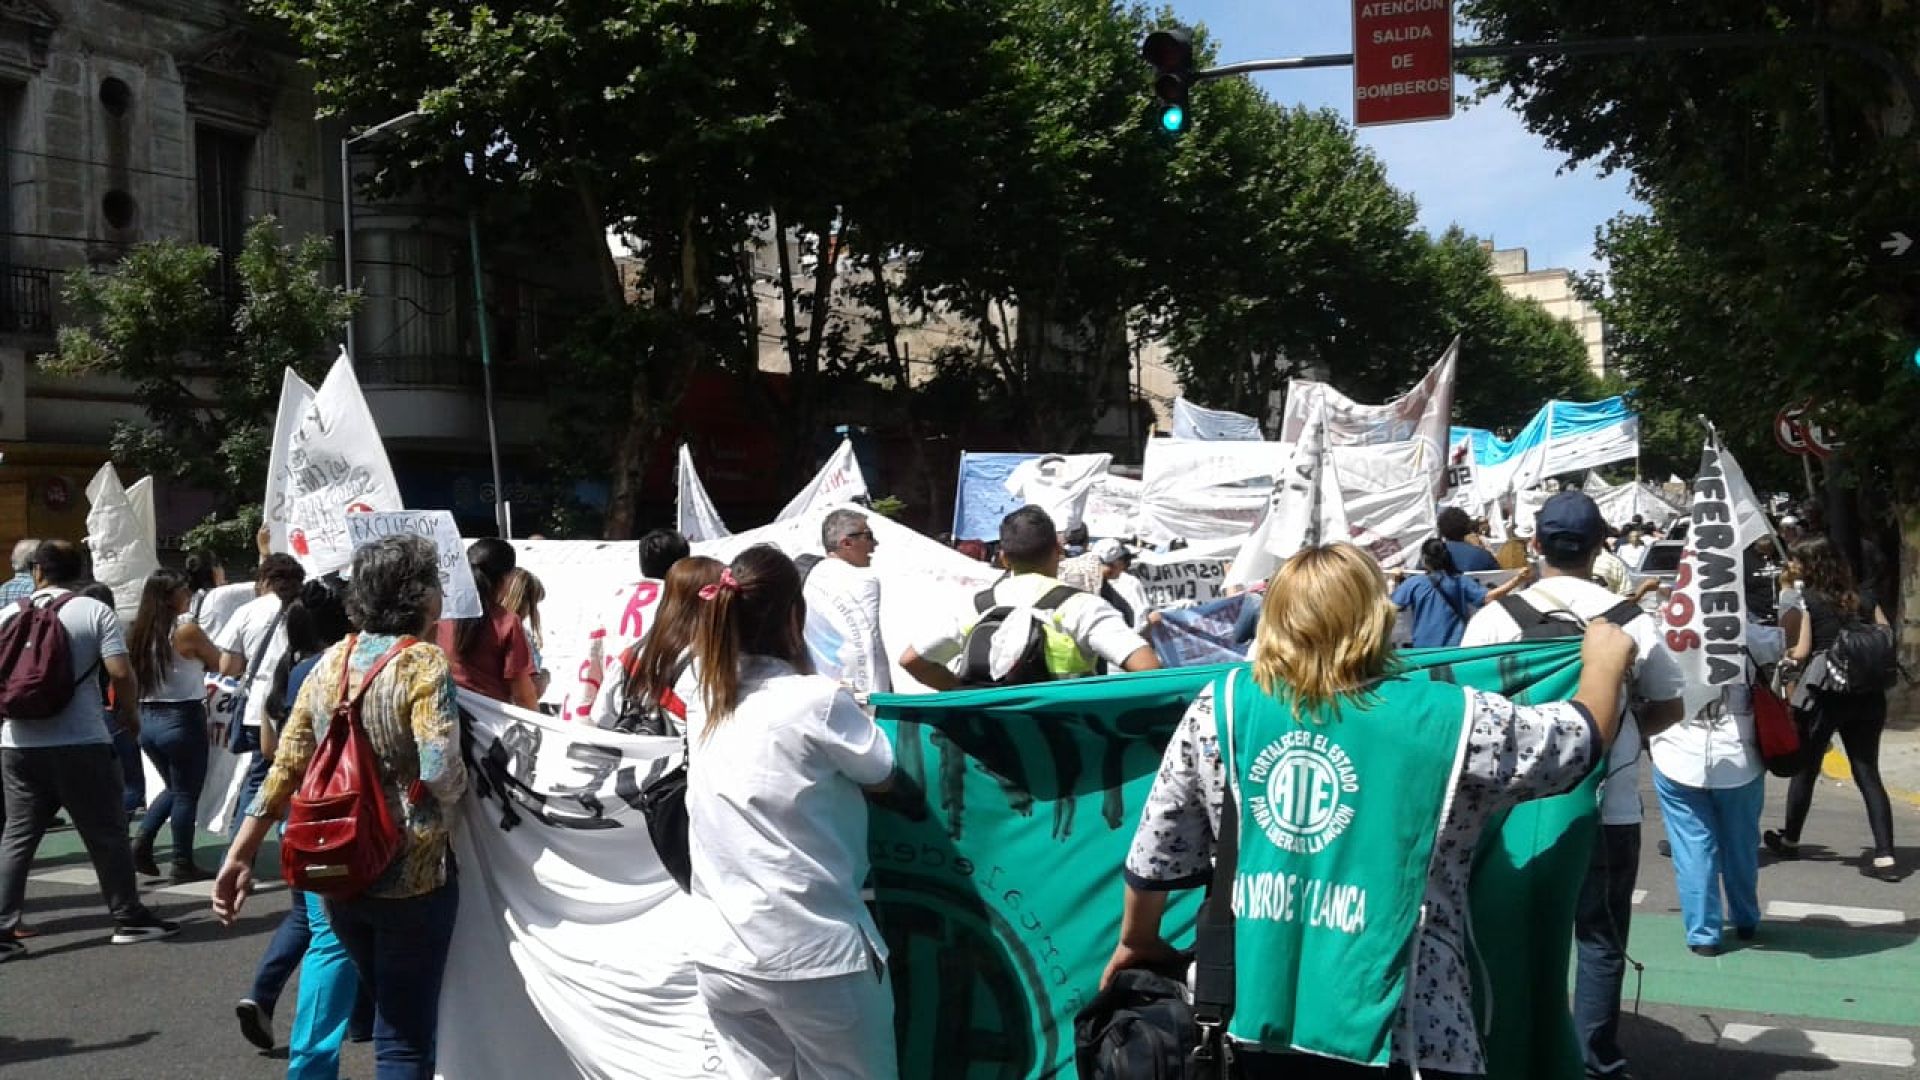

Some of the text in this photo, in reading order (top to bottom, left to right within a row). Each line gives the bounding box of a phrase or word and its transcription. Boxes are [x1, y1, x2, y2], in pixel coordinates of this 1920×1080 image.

[1372, 25, 1432, 44] SALIDA
[1391, 53, 1415, 69] DE
[1357, 77, 1450, 100] BOMBEROS
[1694, 449, 1747, 684] NFERMERÍA
[1274, 757, 1332, 826] ATE
[1313, 734, 1328, 753] EL
[1327, 743, 1359, 793] ESTADO
[1311, 878, 1366, 934] LANCA
